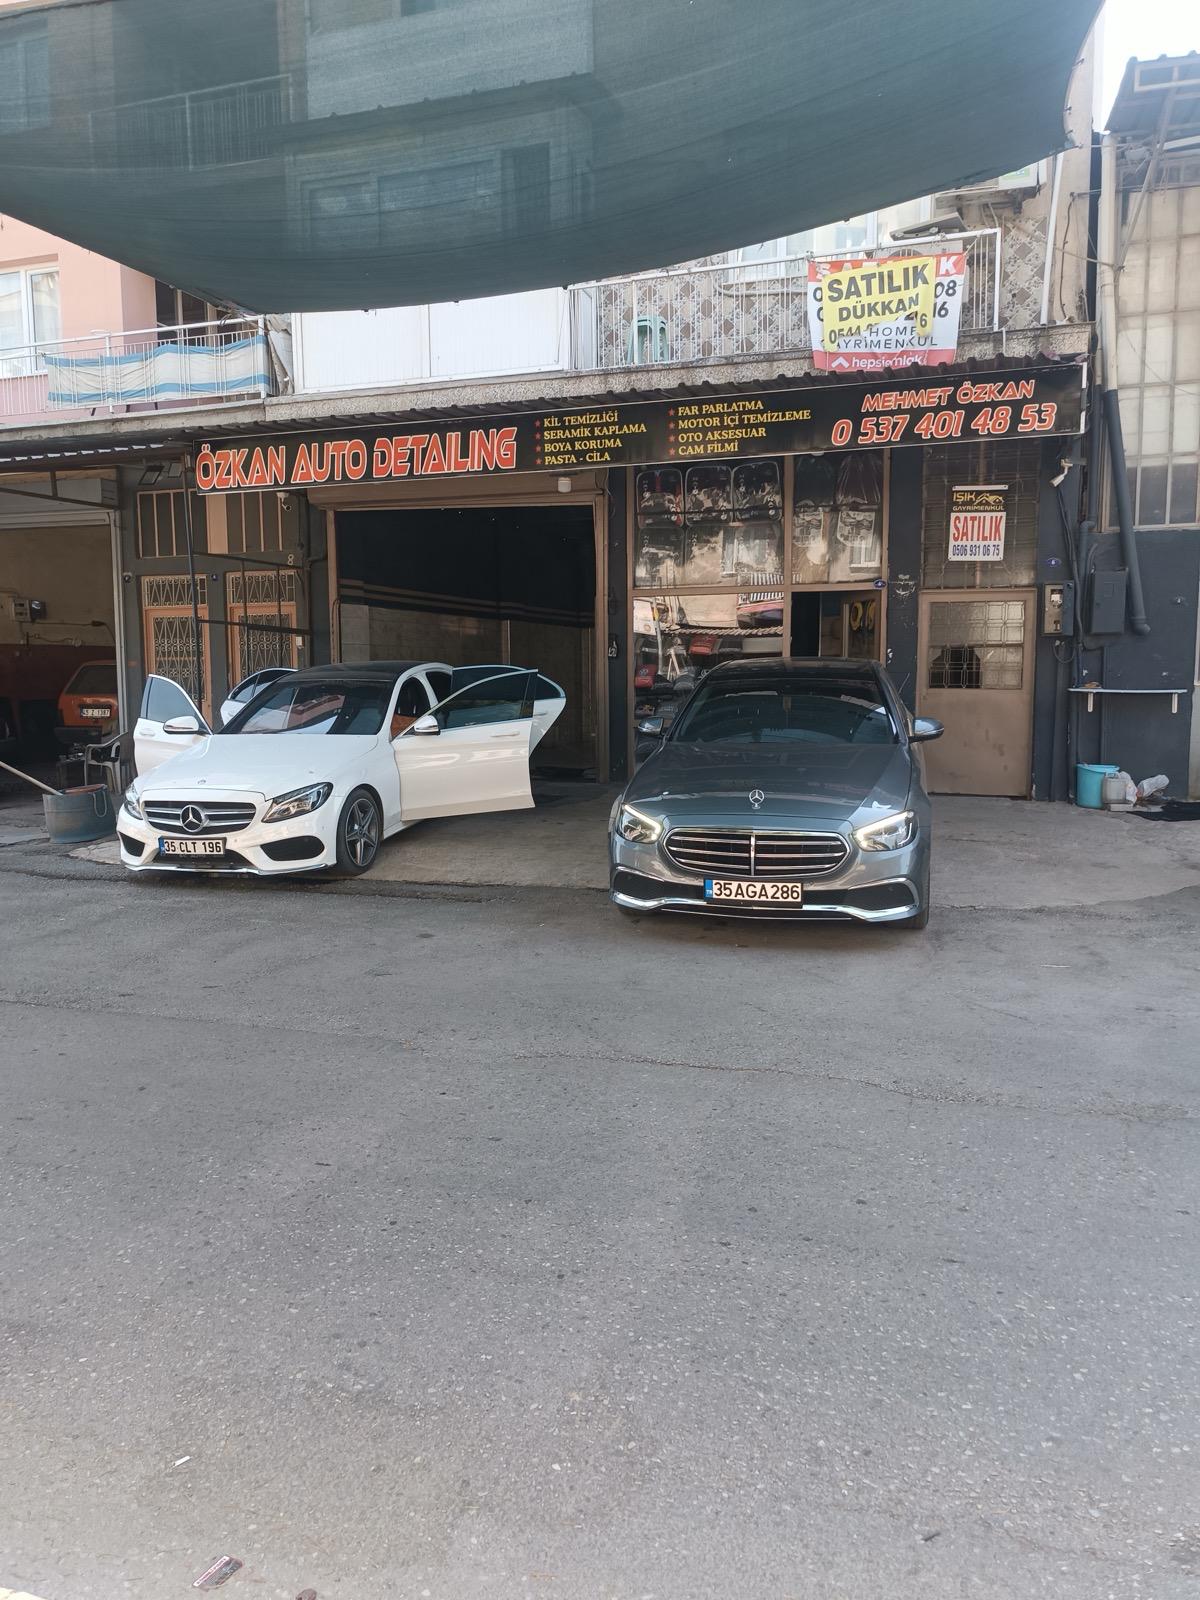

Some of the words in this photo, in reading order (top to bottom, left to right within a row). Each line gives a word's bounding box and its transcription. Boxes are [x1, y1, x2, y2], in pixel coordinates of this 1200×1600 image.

[827, 262, 929, 302] SATILIK
[838, 293, 919, 322] DÜKKAN
[861, 387, 954, 412] MEHMET
[956, 379, 1035, 404] ÖZKAN
[678, 406, 699, 416] FAR
[702, 400, 764, 414] PARLATMA
[544, 415, 561, 427] KİL
[563, 410, 618, 425] TEMİZLİĞİ
[678, 417, 720, 429] MOTOR
[723, 413, 739, 427] İÇİ
[742, 410, 811, 424] TEMİZLEME
[831, 418, 853, 446] 0
[858, 415, 910, 444] 537
[914, 410, 965, 439] 401
[971, 406, 1012, 434] 48
[1018, 403, 1058, 432] 53
[544, 426, 591, 440] SERAMİK
[594, 423, 647, 436] KAPLAMA
[678, 432, 702, 442] OTO
[705, 427, 766, 441] AKSESUAR
[544, 442, 572, 453] BOYA
[575, 438, 622, 450] KORUMA
[678, 445, 704, 455] CAM
[707, 440, 738, 453] FİLMİ
[196, 444, 286, 490] ÖZKAN
[291, 439, 368, 484] AUTO
[372, 427, 518, 479] DETAILING
[545, 455, 577, 465] PASTA
[586, 451, 610, 462] CİLA
[953, 492, 976, 504] IŞIK
[952, 515, 1003, 542] SATILIK
[952, 544, 967, 556] 0506
[969, 544, 980, 556] 931
[982, 544, 990, 556] 06
[992, 544, 1000, 556] 75
[287, 554, 294, 565] 8
[164, 841, 176, 852] 35
[180, 841, 197, 853] CLT
[202, 841, 221, 853] 196
